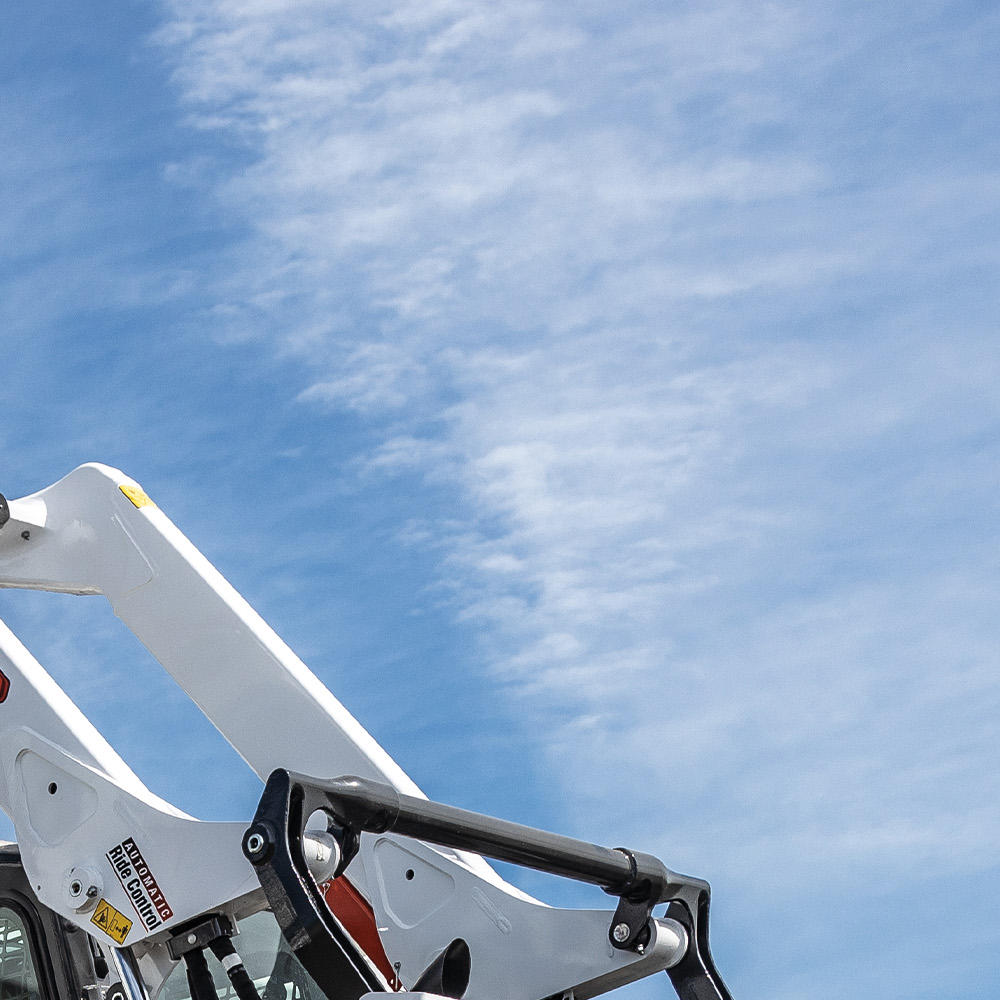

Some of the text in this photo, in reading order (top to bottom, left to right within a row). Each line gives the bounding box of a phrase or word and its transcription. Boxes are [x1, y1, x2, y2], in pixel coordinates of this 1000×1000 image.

[108, 844, 162, 931] Ride Control
[124, 842, 171, 918] AUTOMATIC
